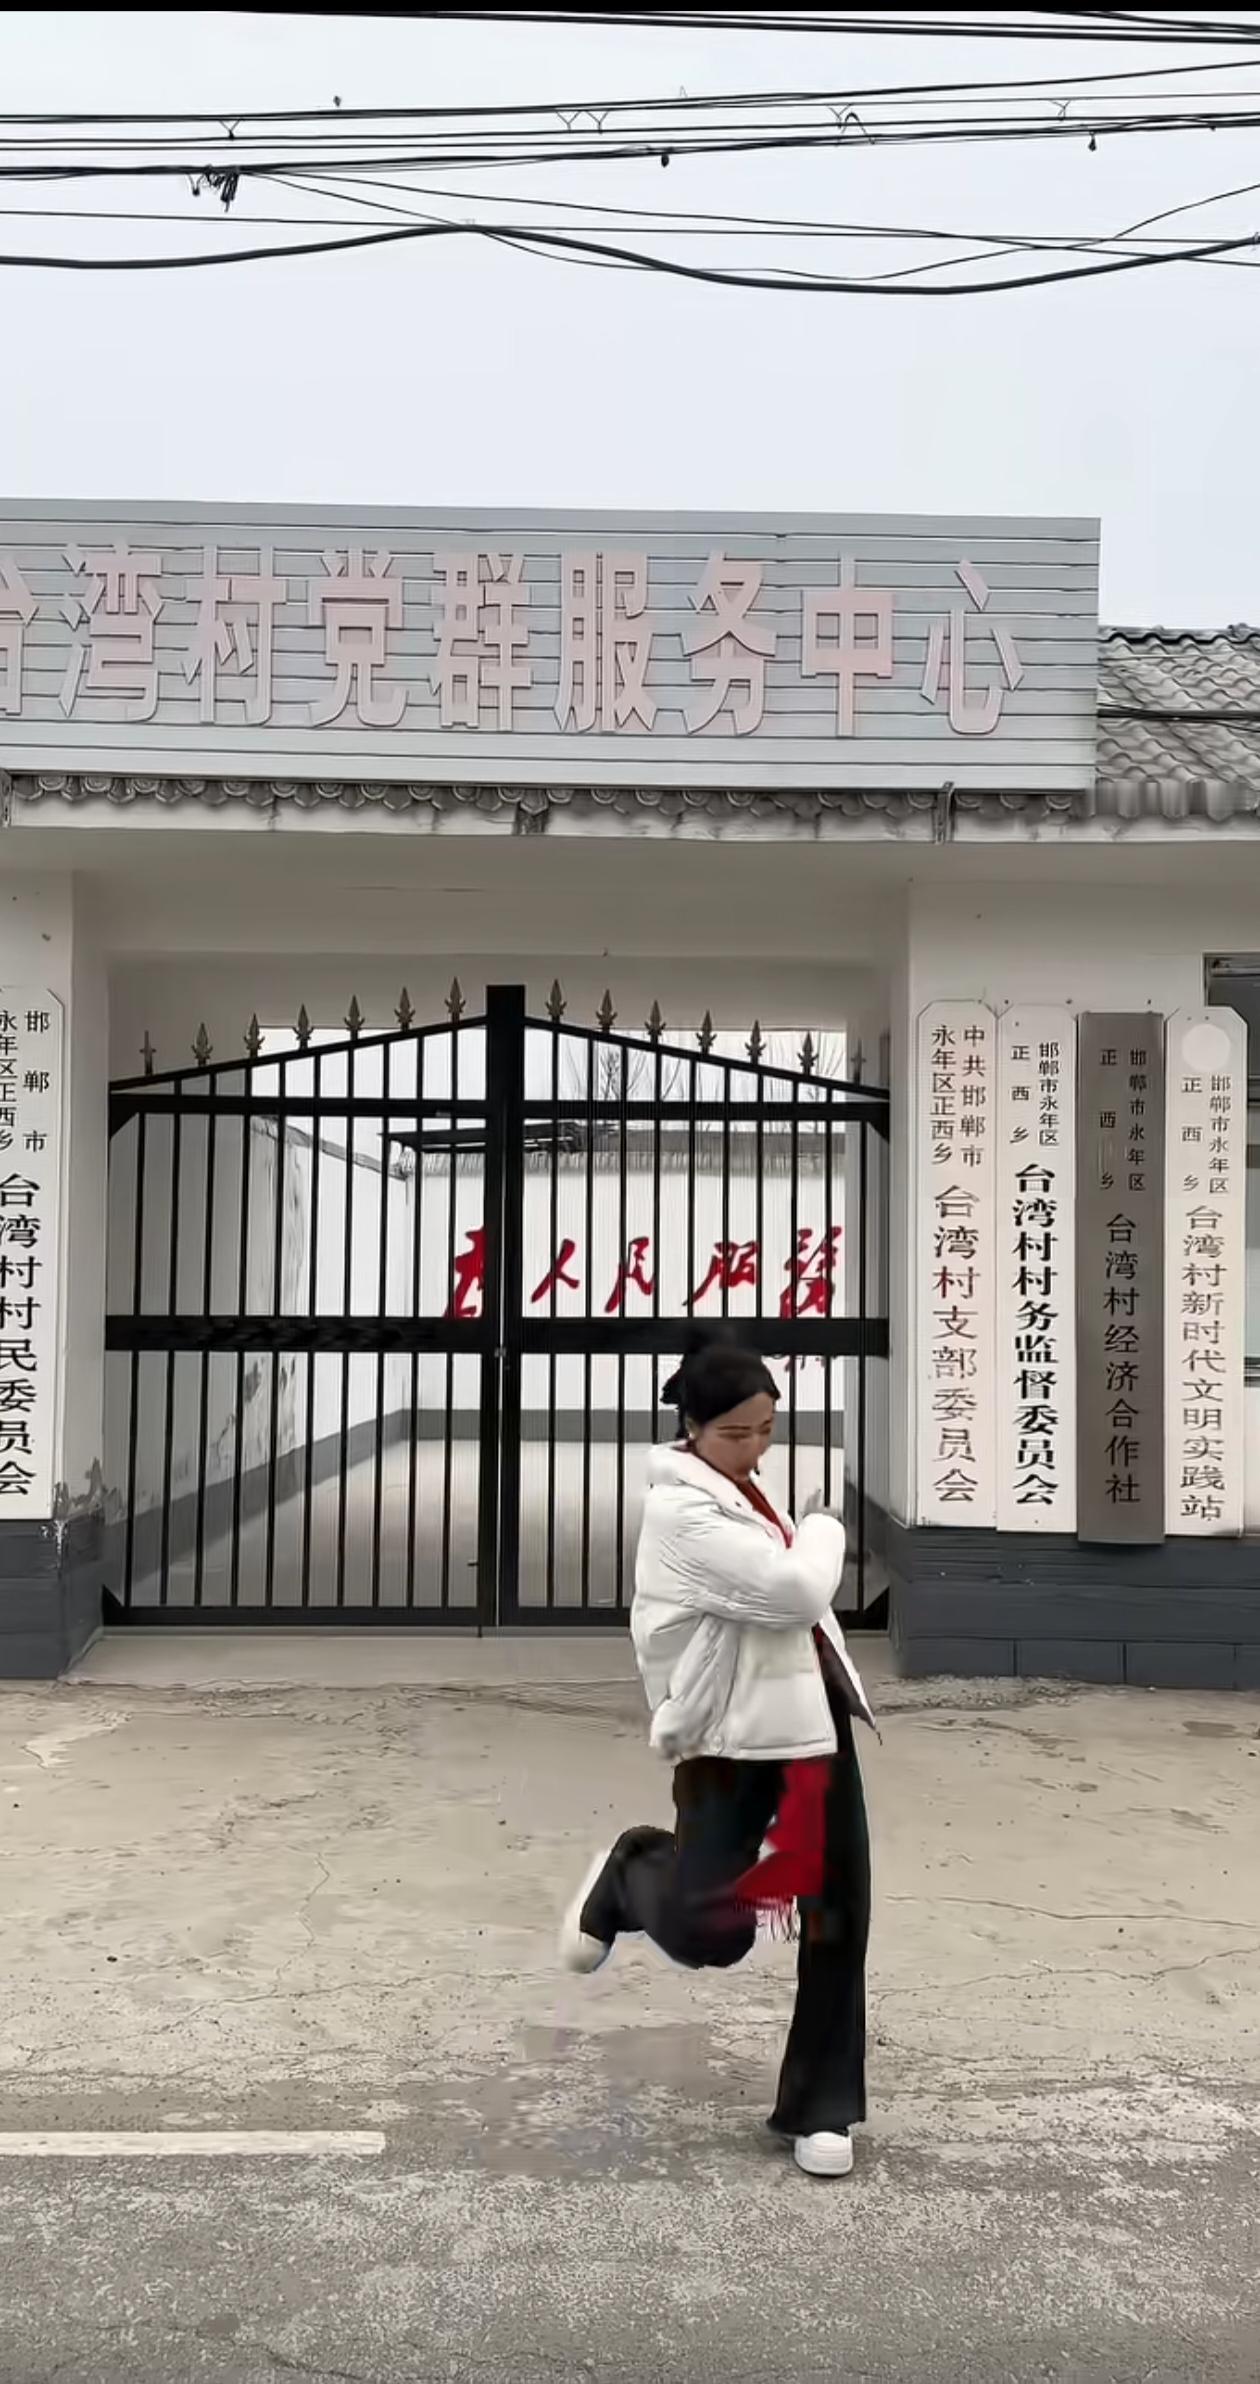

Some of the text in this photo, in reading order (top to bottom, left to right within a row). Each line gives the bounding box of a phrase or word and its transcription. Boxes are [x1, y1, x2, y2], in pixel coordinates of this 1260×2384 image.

[23, 1010, 51, 1152] 邯郸市
[931, 1025, 956, 1165] 永年区正西乡
[960, 1025, 986, 1168] 中共邯郸市
[1010, 1046, 1030, 1144] 正西乡
[1039, 1042, 1060, 1147] 邯郸市永年区
[1100, 1049, 1117, 1190] 正西乡
[1128, 1049, 1147, 1191] 邯郸市永年区
[1182, 1076, 1203, 1192] 正西乡
[1209, 1075, 1231, 1194] 邯郸市永年区
[0, 1173, 42, 1496] 台湾村村民委员会
[932, 1185, 980, 1503] 台湾村支部委员会
[1012, 1163, 1059, 1505] 台湾村村务监督委员会
[1103, 1213, 1141, 1504] 台湾村经济合作社
[1181, 1205, 1228, 1520] 台湾村新时代文明实践站
